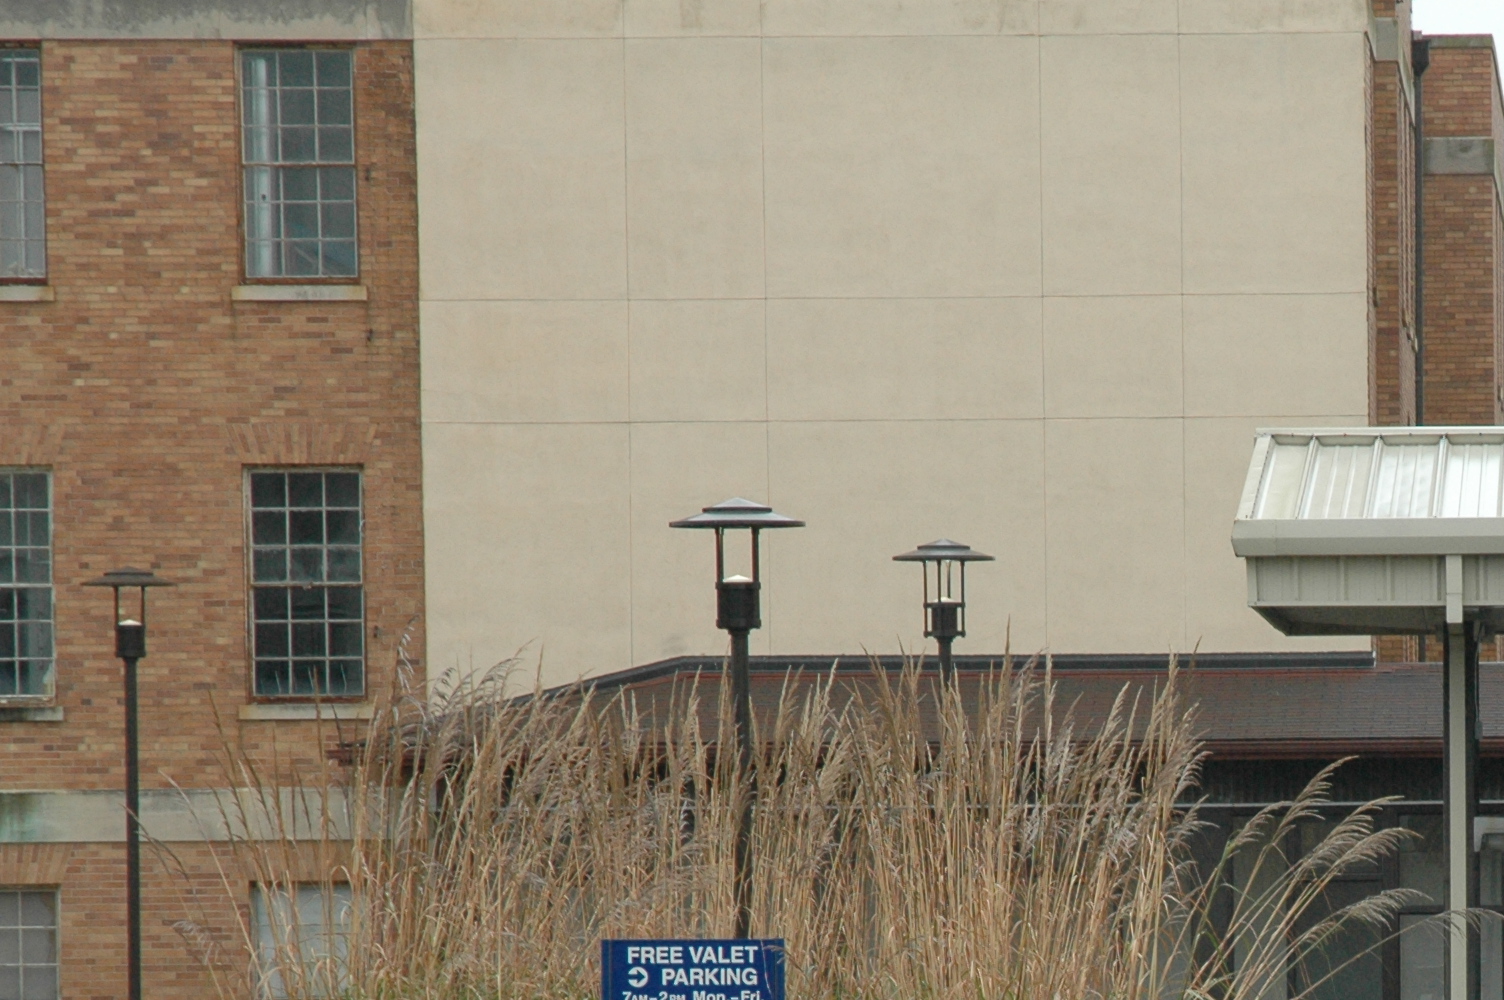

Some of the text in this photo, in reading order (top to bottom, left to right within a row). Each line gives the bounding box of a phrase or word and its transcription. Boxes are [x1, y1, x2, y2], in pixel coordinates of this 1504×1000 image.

[627, 946, 757, 964] FREE VALET
[661, 968, 758, 986] PARKING
